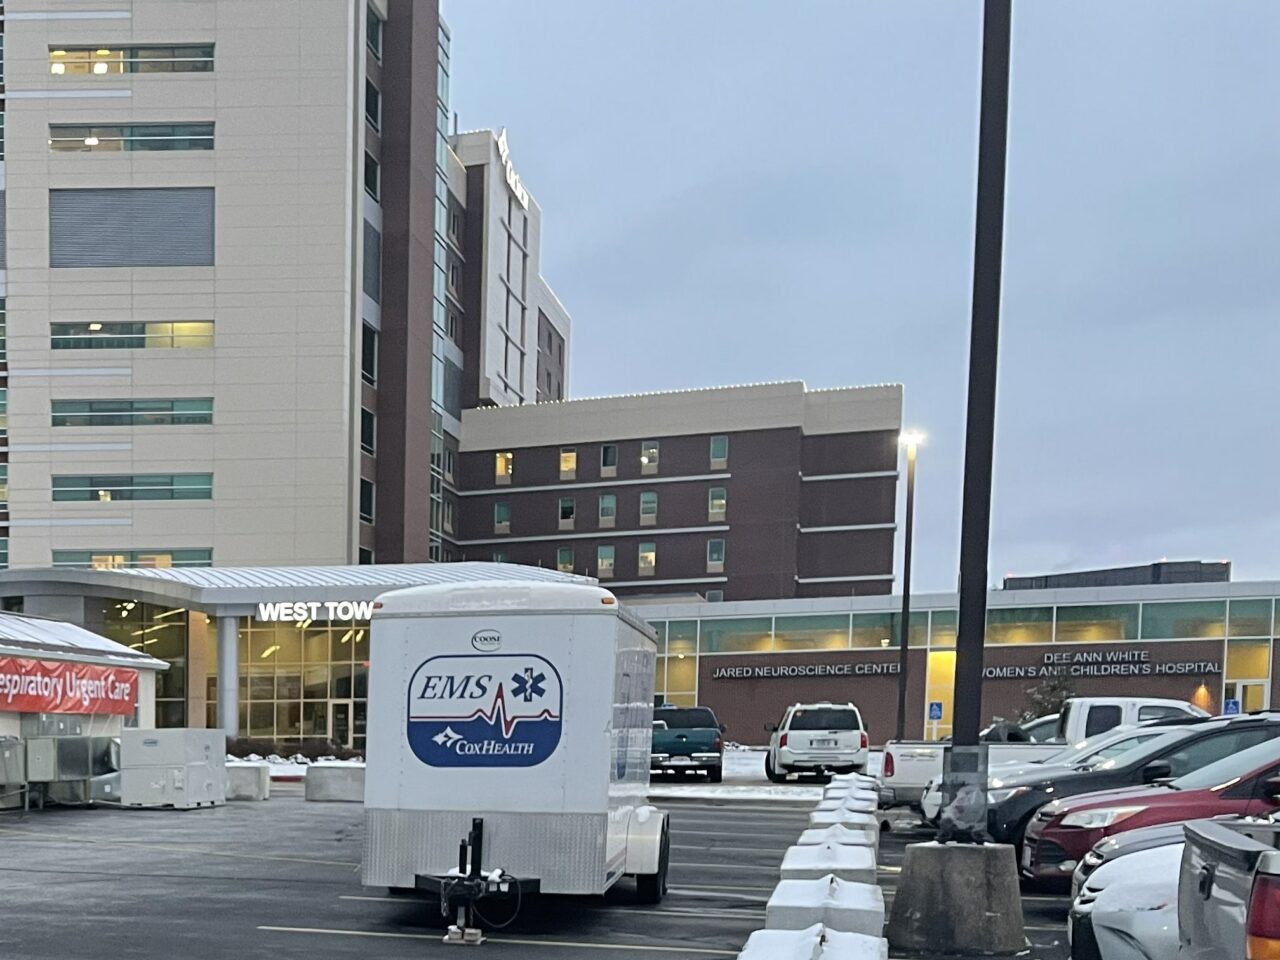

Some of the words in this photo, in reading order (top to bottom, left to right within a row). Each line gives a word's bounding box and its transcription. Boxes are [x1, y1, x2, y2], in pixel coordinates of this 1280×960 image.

[258, 601, 321, 621] WEST
[1044, 652, 1071, 664] DEE
[1073, 651, 1102, 663] ANN
[1106, 650, 1149, 662] WHITE
[712, 667, 752, 678] JARED
[755, 663, 852, 677] NEUROSCIENCE
[1070, 663, 1151, 676] CHILDREN'S
[1156, 661, 1222, 675] HOSPITAL
[65, 670, 105, 706] Urgent
[108, 674, 130, 701] Care
[417, 674, 493, 700] EMS
